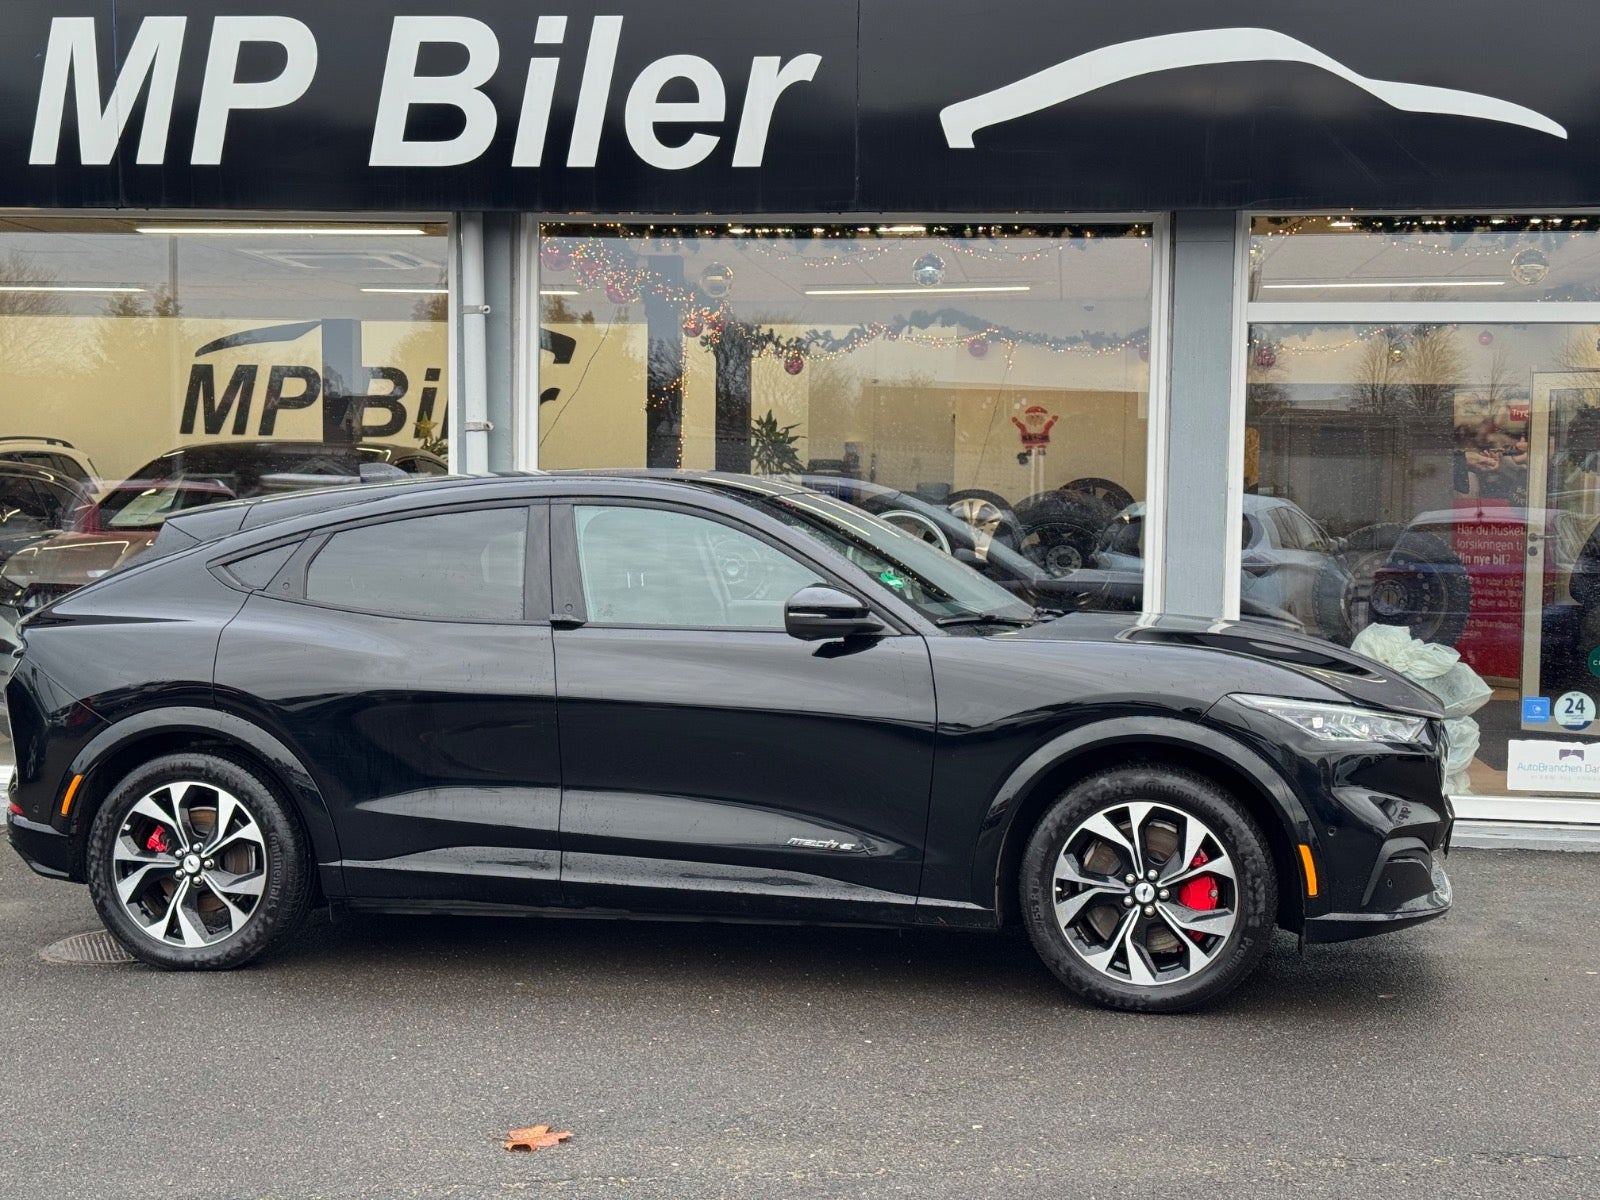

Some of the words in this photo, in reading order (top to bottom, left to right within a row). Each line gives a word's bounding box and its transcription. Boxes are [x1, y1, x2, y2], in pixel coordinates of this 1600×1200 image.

[29, 16, 318, 165] MP
[368, 15, 823, 170] Biler
[179, 364, 323, 437] MP
[1457, 524, 1474, 535] Har
[1476, 525, 1489, 536] du
[1491, 525, 1525, 536] husket
[1473, 554, 1491, 567] nye
[1492, 553, 1511, 566] bil?
[1564, 697, 1586, 714] 24
[1517, 762, 1582, 774] AutoBranchen
